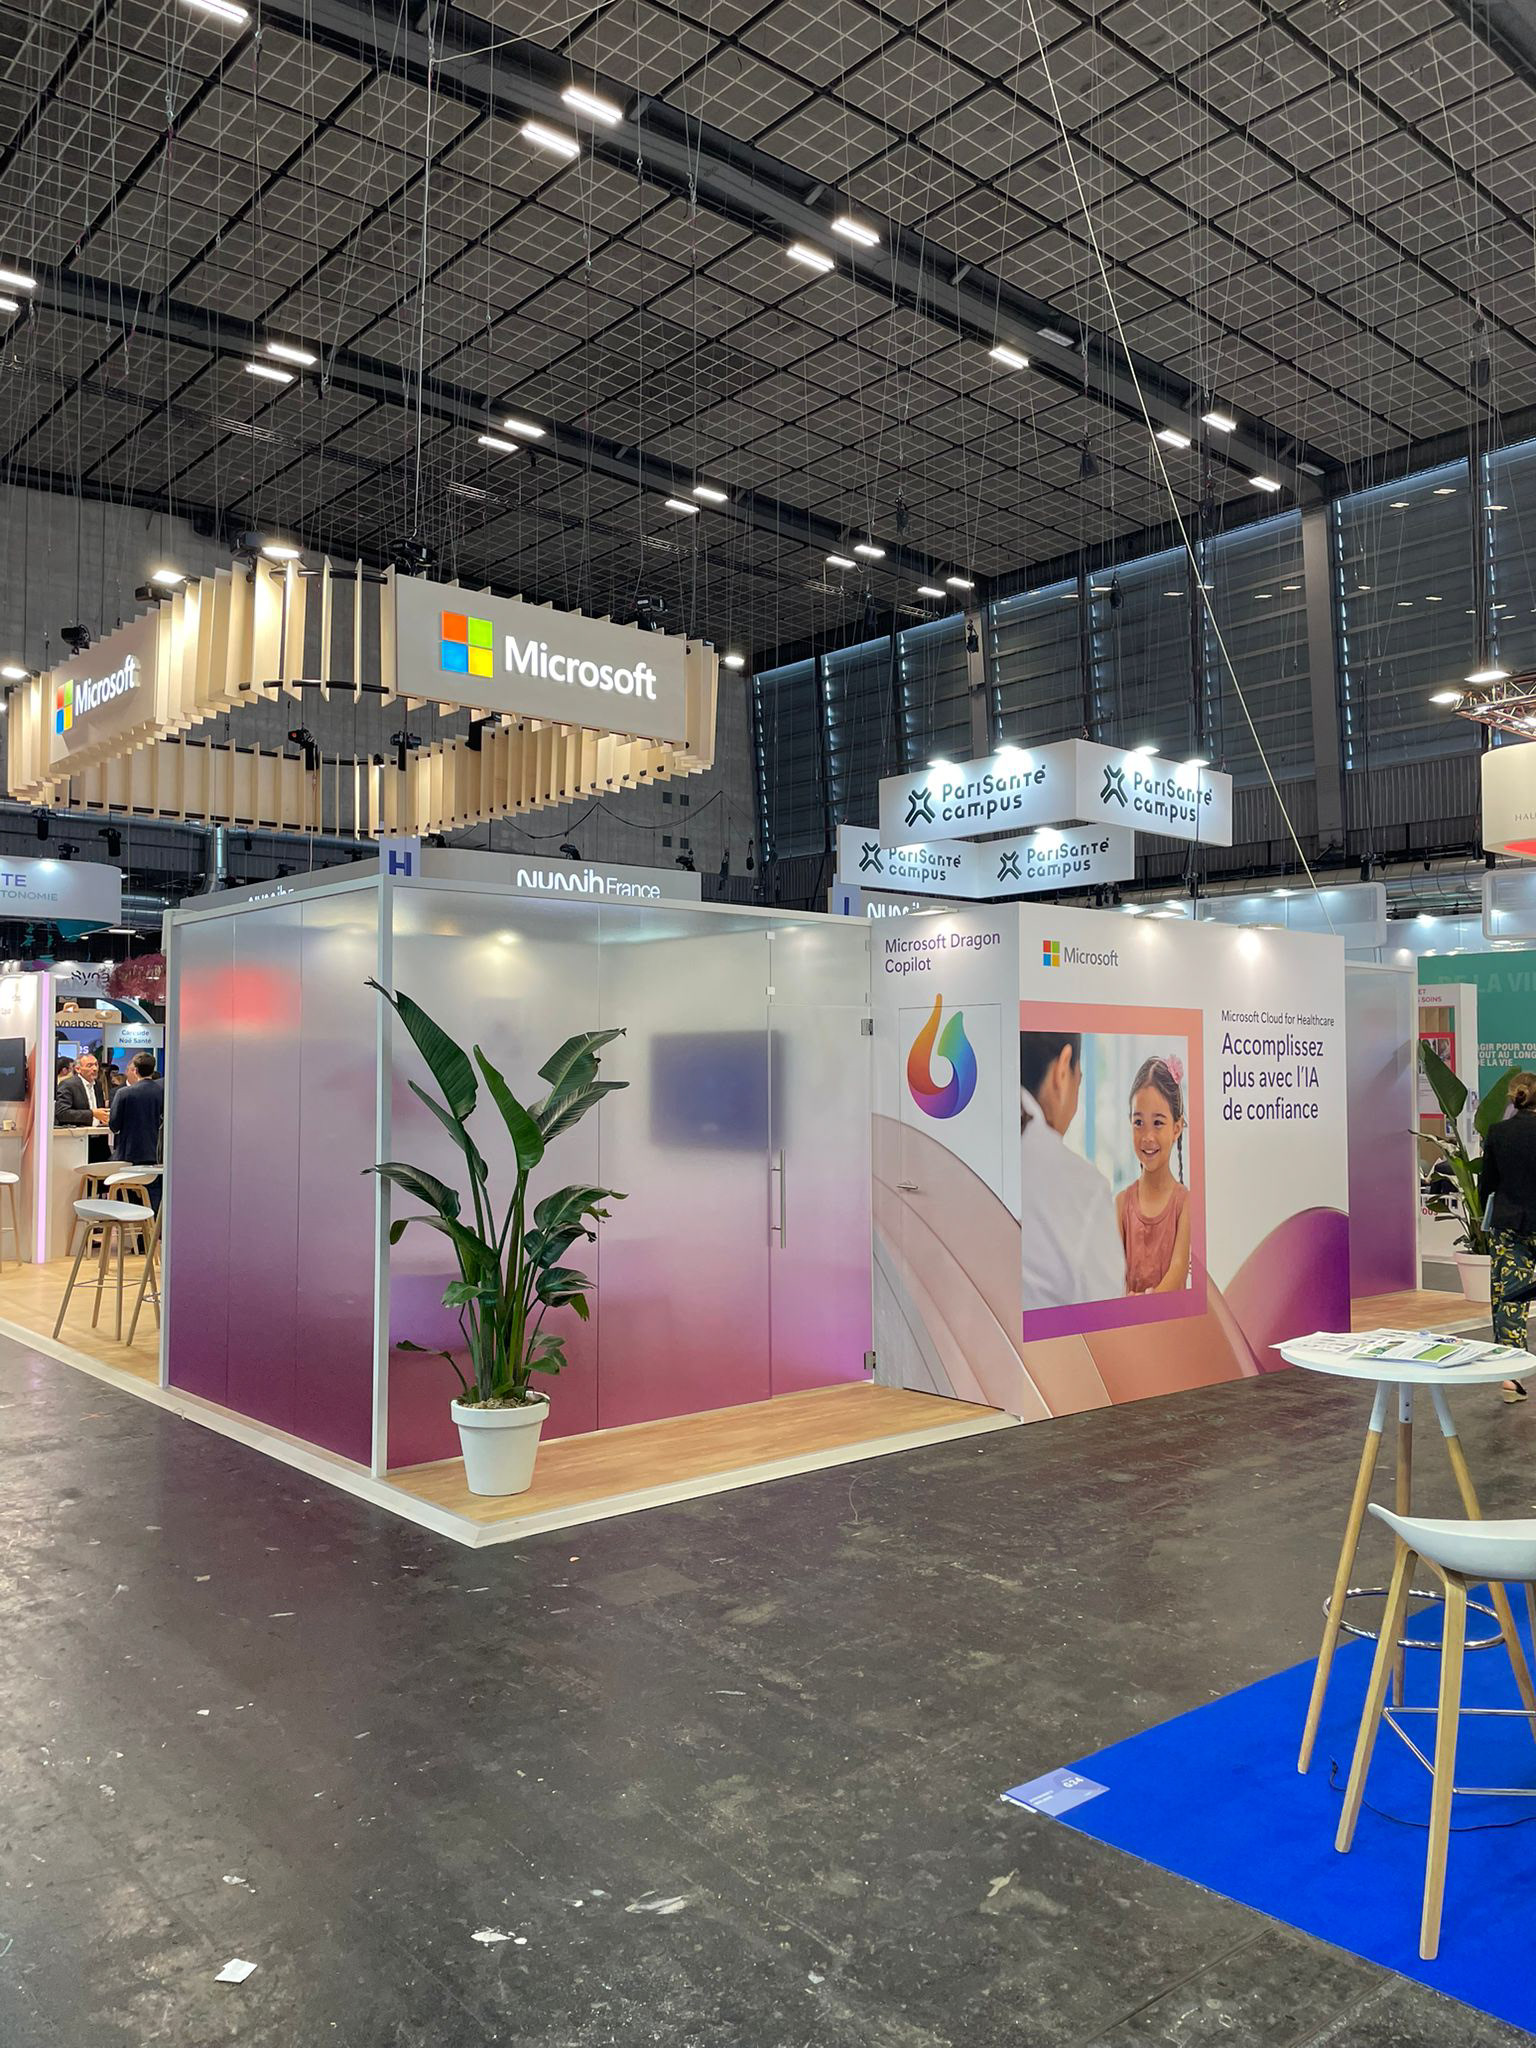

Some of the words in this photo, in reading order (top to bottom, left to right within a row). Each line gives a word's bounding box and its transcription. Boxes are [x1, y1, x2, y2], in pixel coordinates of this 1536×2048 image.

[505, 635, 657, 700] Microsoft
[75, 654, 137, 716] Microsoft
[942, 794, 1023, 821] campus
[1134, 799, 1196, 823] campus
[389, 851, 412, 876] H
[889, 865, 946, 883] campus
[1027, 859, 1091, 881] campus
[606, 877, 661, 899] France
[885, 934, 946, 953] Microsoft
[950, 932, 1001, 950] Dragon
[885, 957, 931, 975] Copilot
[1064, 947, 1119, 967] Microsoft
[1221, 1010, 1259, 1023] Microsoft
[1261, 1011, 1283, 1024] Cloud
[1285, 1012, 1295, 1024] for
[1297, 1014, 1335, 1027] Healthcare
[1222, 1032, 1324, 1062] Accomplissez
[1478, 1043, 1494, 1051] GIR
[1496, 1043, 1520, 1051] POUR
[1498, 1051, 1510, 1059] AU
[1223, 1064, 1255, 1094] plus
[1259, 1071, 1293, 1088] avec
[1297, 1065, 1319, 1088] l'IA
[1223, 1097, 1242, 1120] de
[1247, 1097, 1319, 1120] confiance
